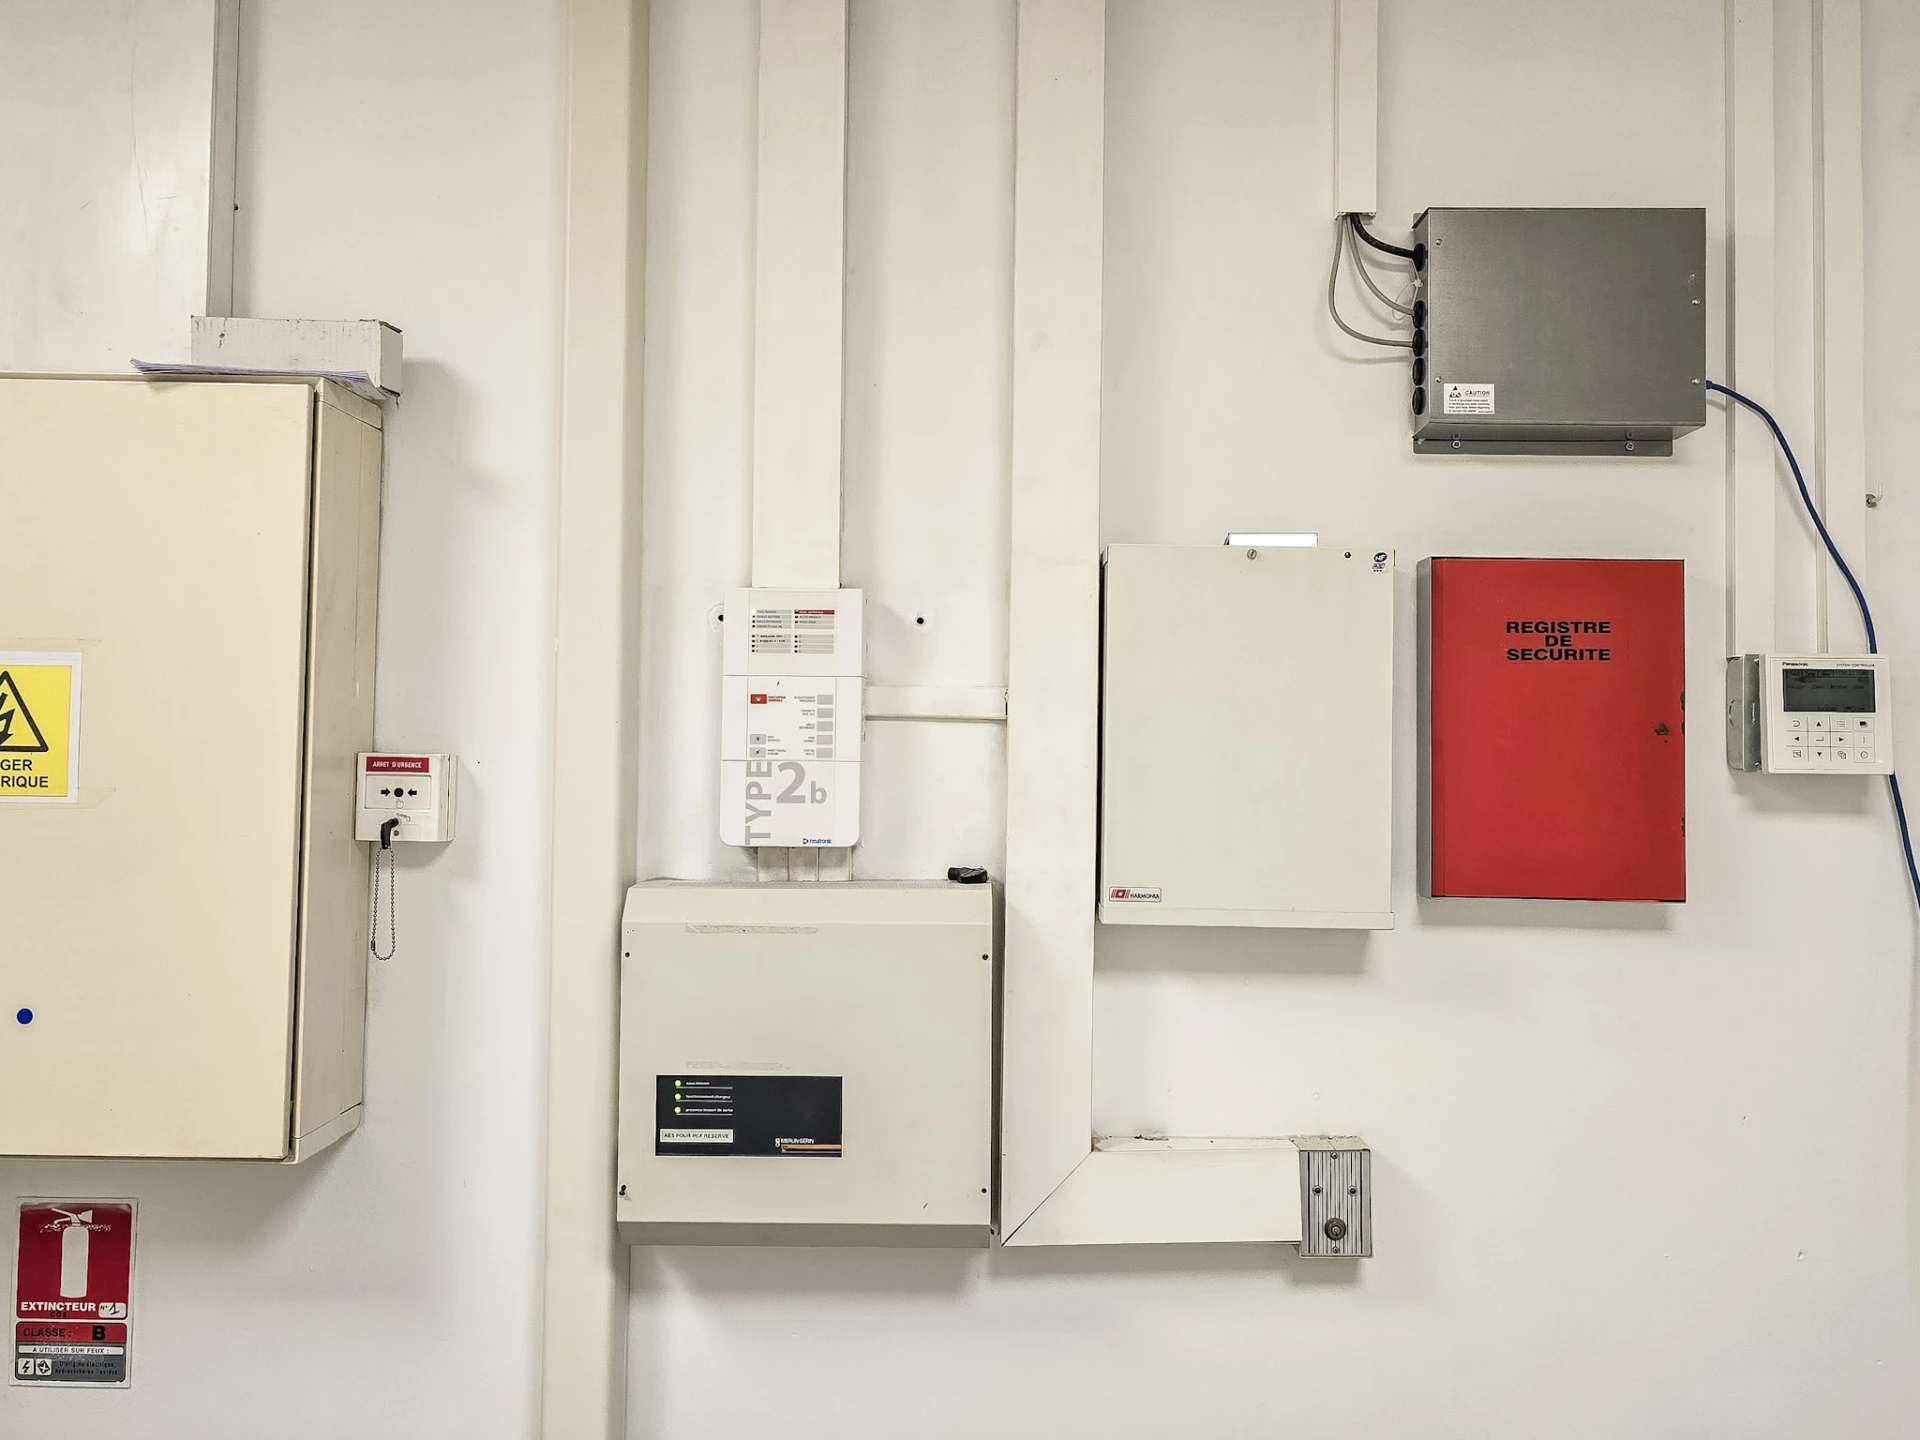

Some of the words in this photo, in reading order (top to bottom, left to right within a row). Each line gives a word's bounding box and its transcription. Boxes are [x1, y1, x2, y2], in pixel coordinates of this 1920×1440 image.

[1506, 621, 1611, 634] REGISTRE
[1545, 635, 1572, 647] DE
[1506, 648, 1611, 661] SECURITE
[745, 761, 772, 846] TYPE
[20, 1301, 96, 1312] EXTINCTEUR
[109, 1303, 120, 1315] 1
[23, 1327, 66, 1337] CLASSE
[92, 1325, 106, 1341] B
